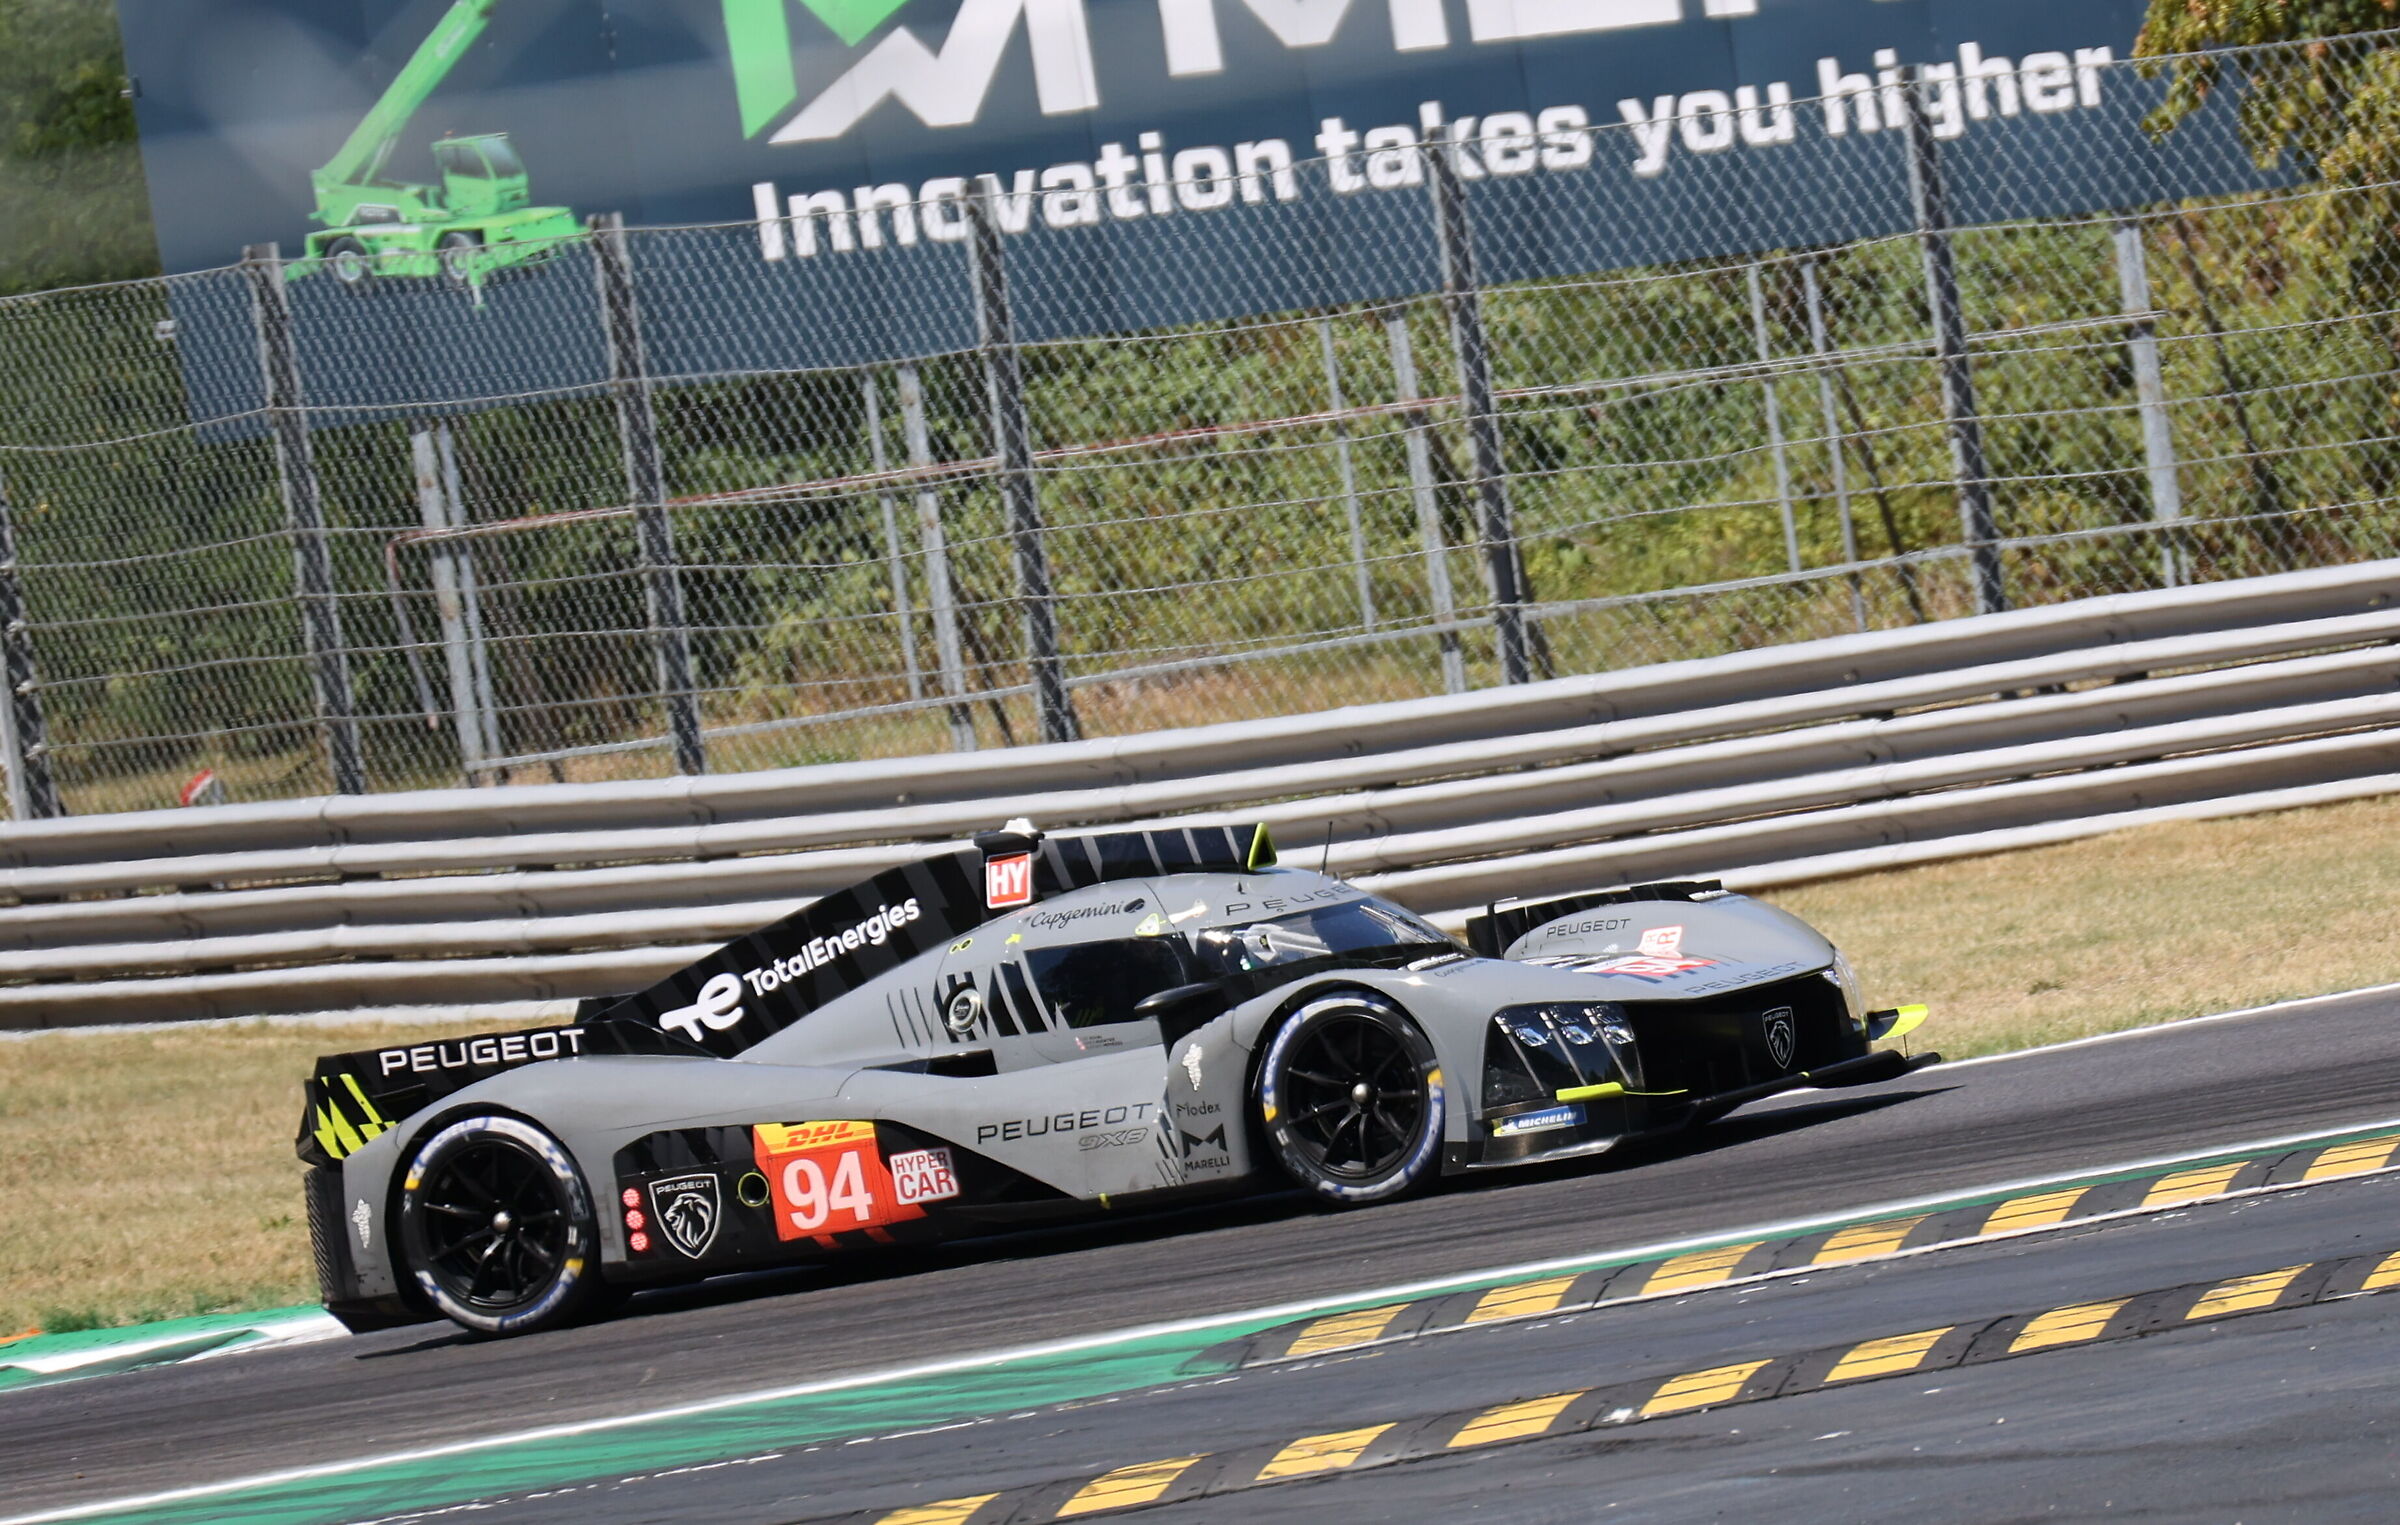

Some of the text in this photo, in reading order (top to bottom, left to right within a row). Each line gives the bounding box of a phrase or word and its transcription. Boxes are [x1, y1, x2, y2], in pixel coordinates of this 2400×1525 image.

[752, 41, 2113, 262] Innovation takes you higher
[990, 861, 1027, 897] HY
[1030, 900, 1124, 930] Capgemini
[1225, 886, 1352, 916] PEUGE
[1545, 918, 1631, 939] PEUGEOT
[743, 897, 920, 998] TotalEnergies
[379, 1028, 586, 1076] PEUGEOT
[977, 1102, 1153, 1144] PEUGEOT
[1518, 1111, 1577, 1128] MICHELIN
[786, 1122, 855, 1148] DHL
[894, 1151, 949, 1175] HYPER
[1184, 1156, 1231, 1171] MARELLI
[656, 1180, 713, 1195] PEUGEOT
[782, 1150, 873, 1230] 94
[899, 1168, 953, 1200] CAR
